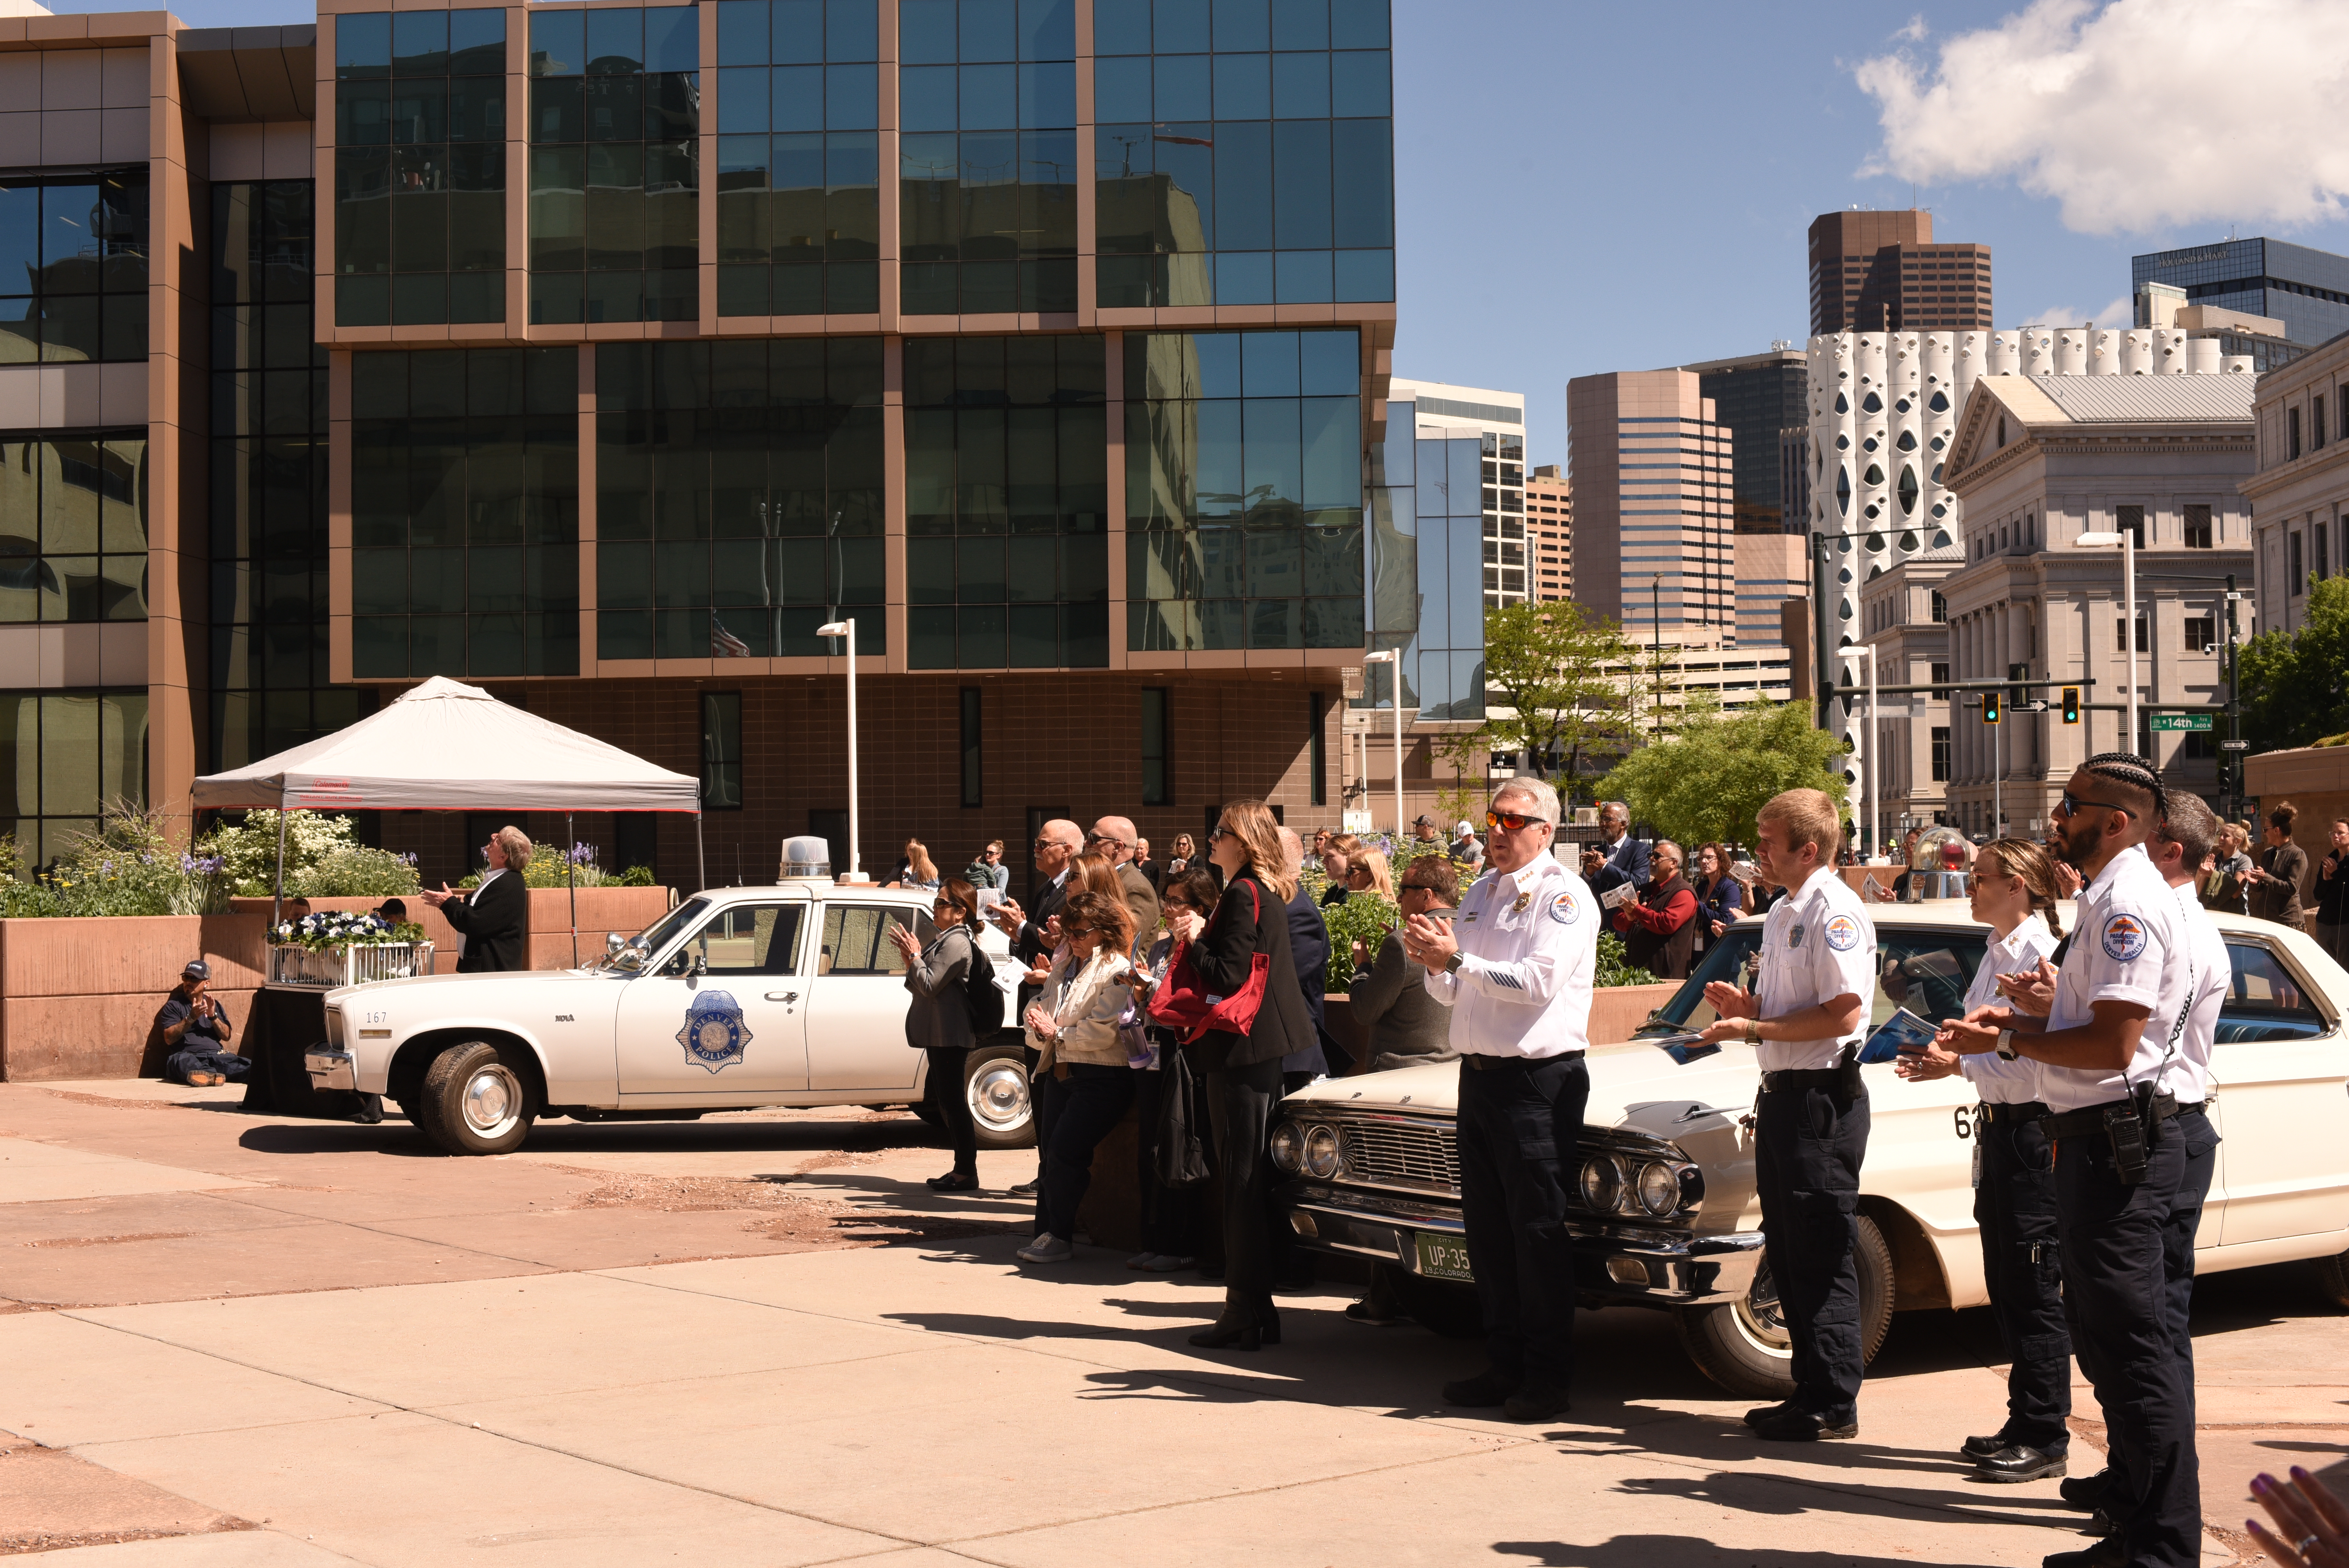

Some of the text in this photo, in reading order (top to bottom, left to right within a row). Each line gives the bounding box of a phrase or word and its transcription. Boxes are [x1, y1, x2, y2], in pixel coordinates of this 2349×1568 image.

[2159, 256, 2196, 267] HOLLAND
[2205, 251, 2228, 260] HART
[2168, 717, 2192, 728] 14th
[1552, 910, 1565, 921] DENVER
[1827, 936, 1857, 948] DENVER HEALTH
[2105, 941, 2143, 958] DENVER HEALTH
[366, 1012, 387, 1024] 167
[555, 1014, 575, 1022] NOVA
[694, 1014, 736, 1031] DENVER
[695, 1045, 733, 1060] POLICE
[1435, 1268, 1471, 1279] COLORADO
